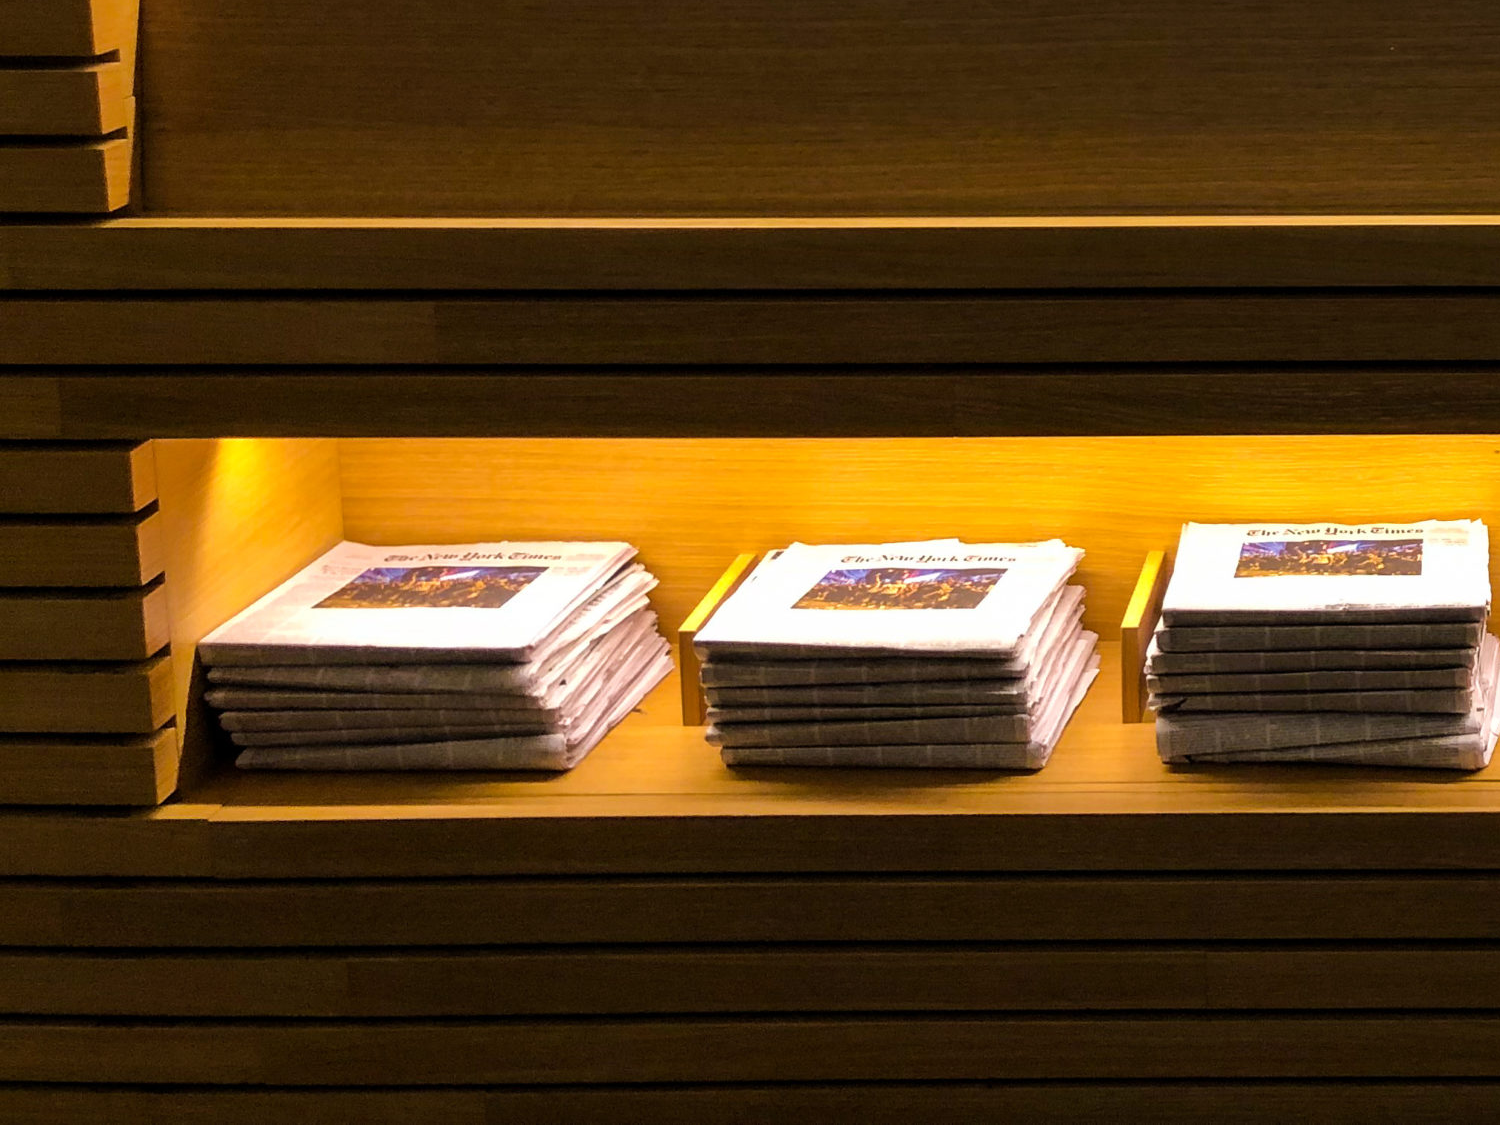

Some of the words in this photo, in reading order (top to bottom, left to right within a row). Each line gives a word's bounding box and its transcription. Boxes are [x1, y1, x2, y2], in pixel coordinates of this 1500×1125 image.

[1245, 528, 1281, 536] The
[1282, 528, 1321, 536] New
[1323, 527, 1368, 536] York
[1369, 526, 1425, 535] Times
[384, 552, 419, 562] The
[419, 552, 458, 562] New
[458, 551, 504, 562] York
[507, 552, 562, 561] Times
[840, 555, 873, 564] The
[963, 554, 1017, 563] Times
